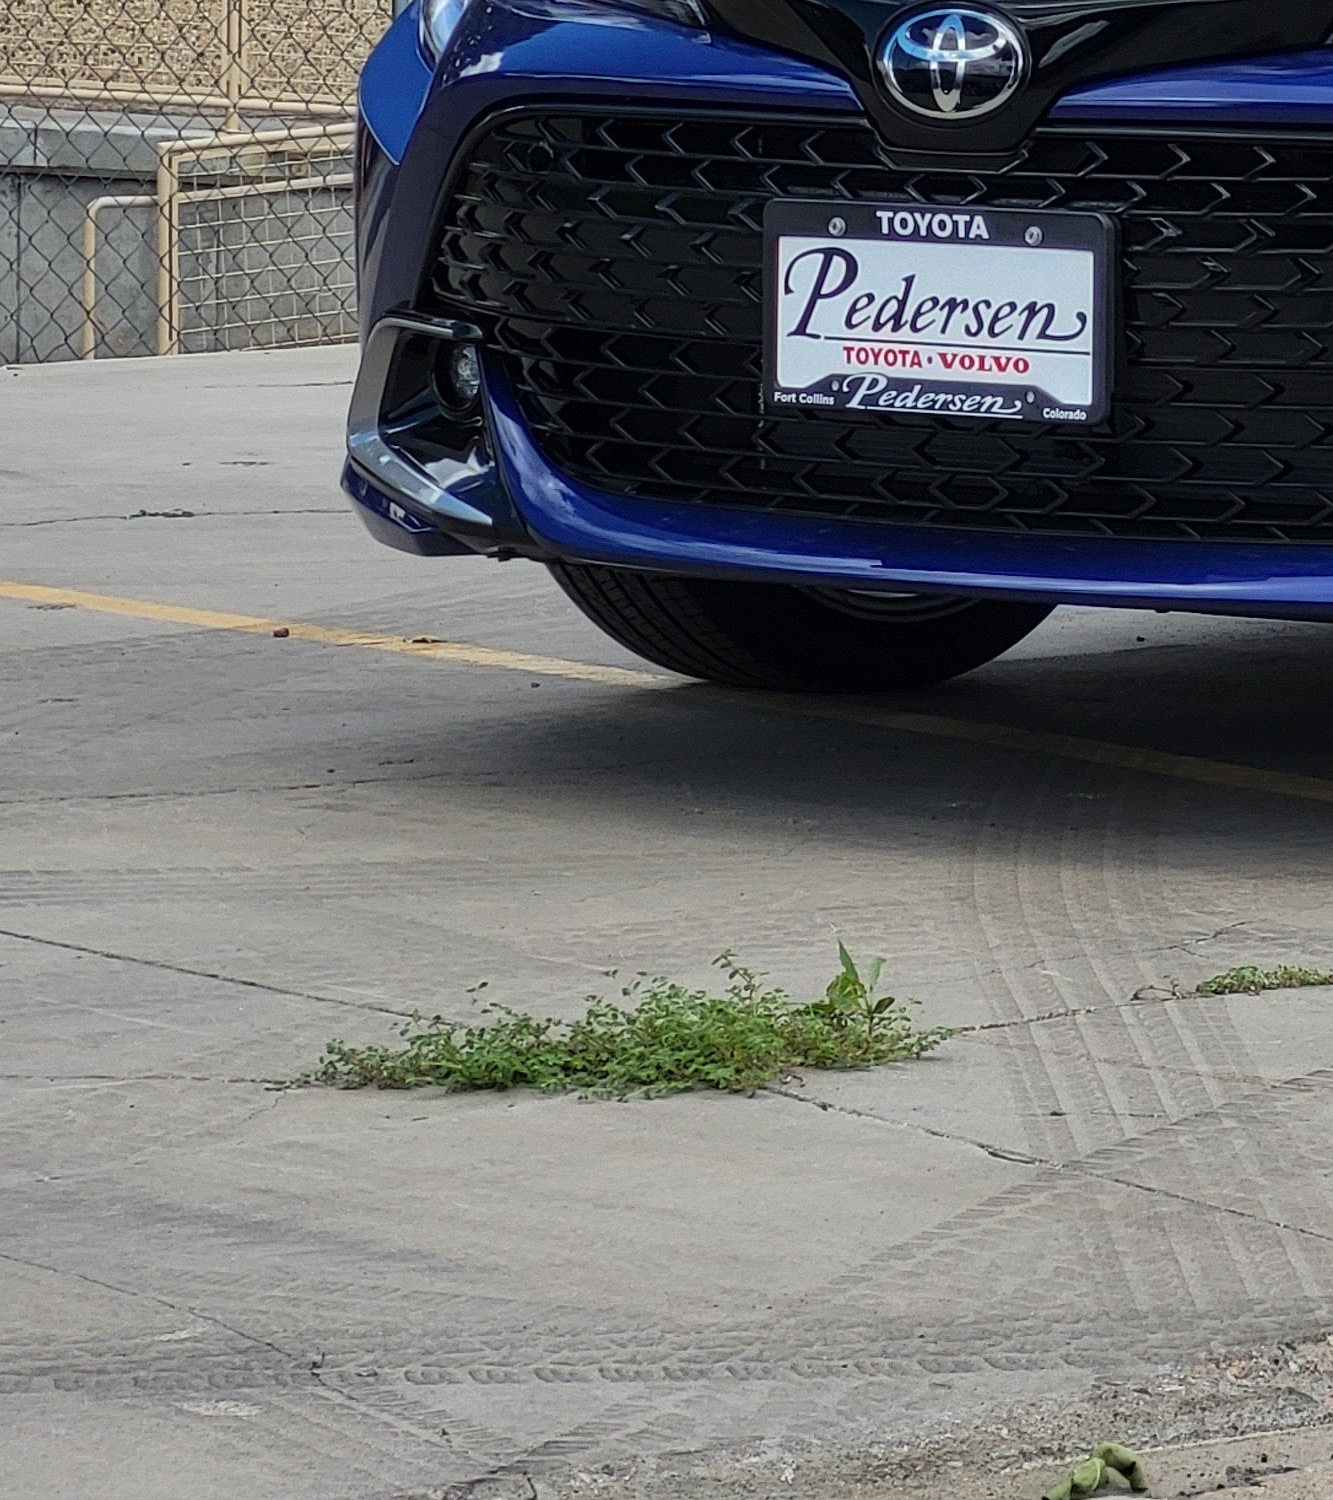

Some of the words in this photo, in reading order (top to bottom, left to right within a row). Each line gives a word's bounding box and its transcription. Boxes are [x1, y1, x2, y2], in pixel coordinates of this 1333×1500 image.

[875, 210, 990, 240] TOYOTA
[783, 246, 1088, 342] Pedersen
[843, 346, 923, 369] TOYOTA
[937, 352, 1030, 374] VOLVO
[774, 391, 797, 403] Fort
[799, 393, 835, 406] Collins
[842, 373, 1023, 414] Pedersen
[1043, 407, 1087, 421] Colorado
